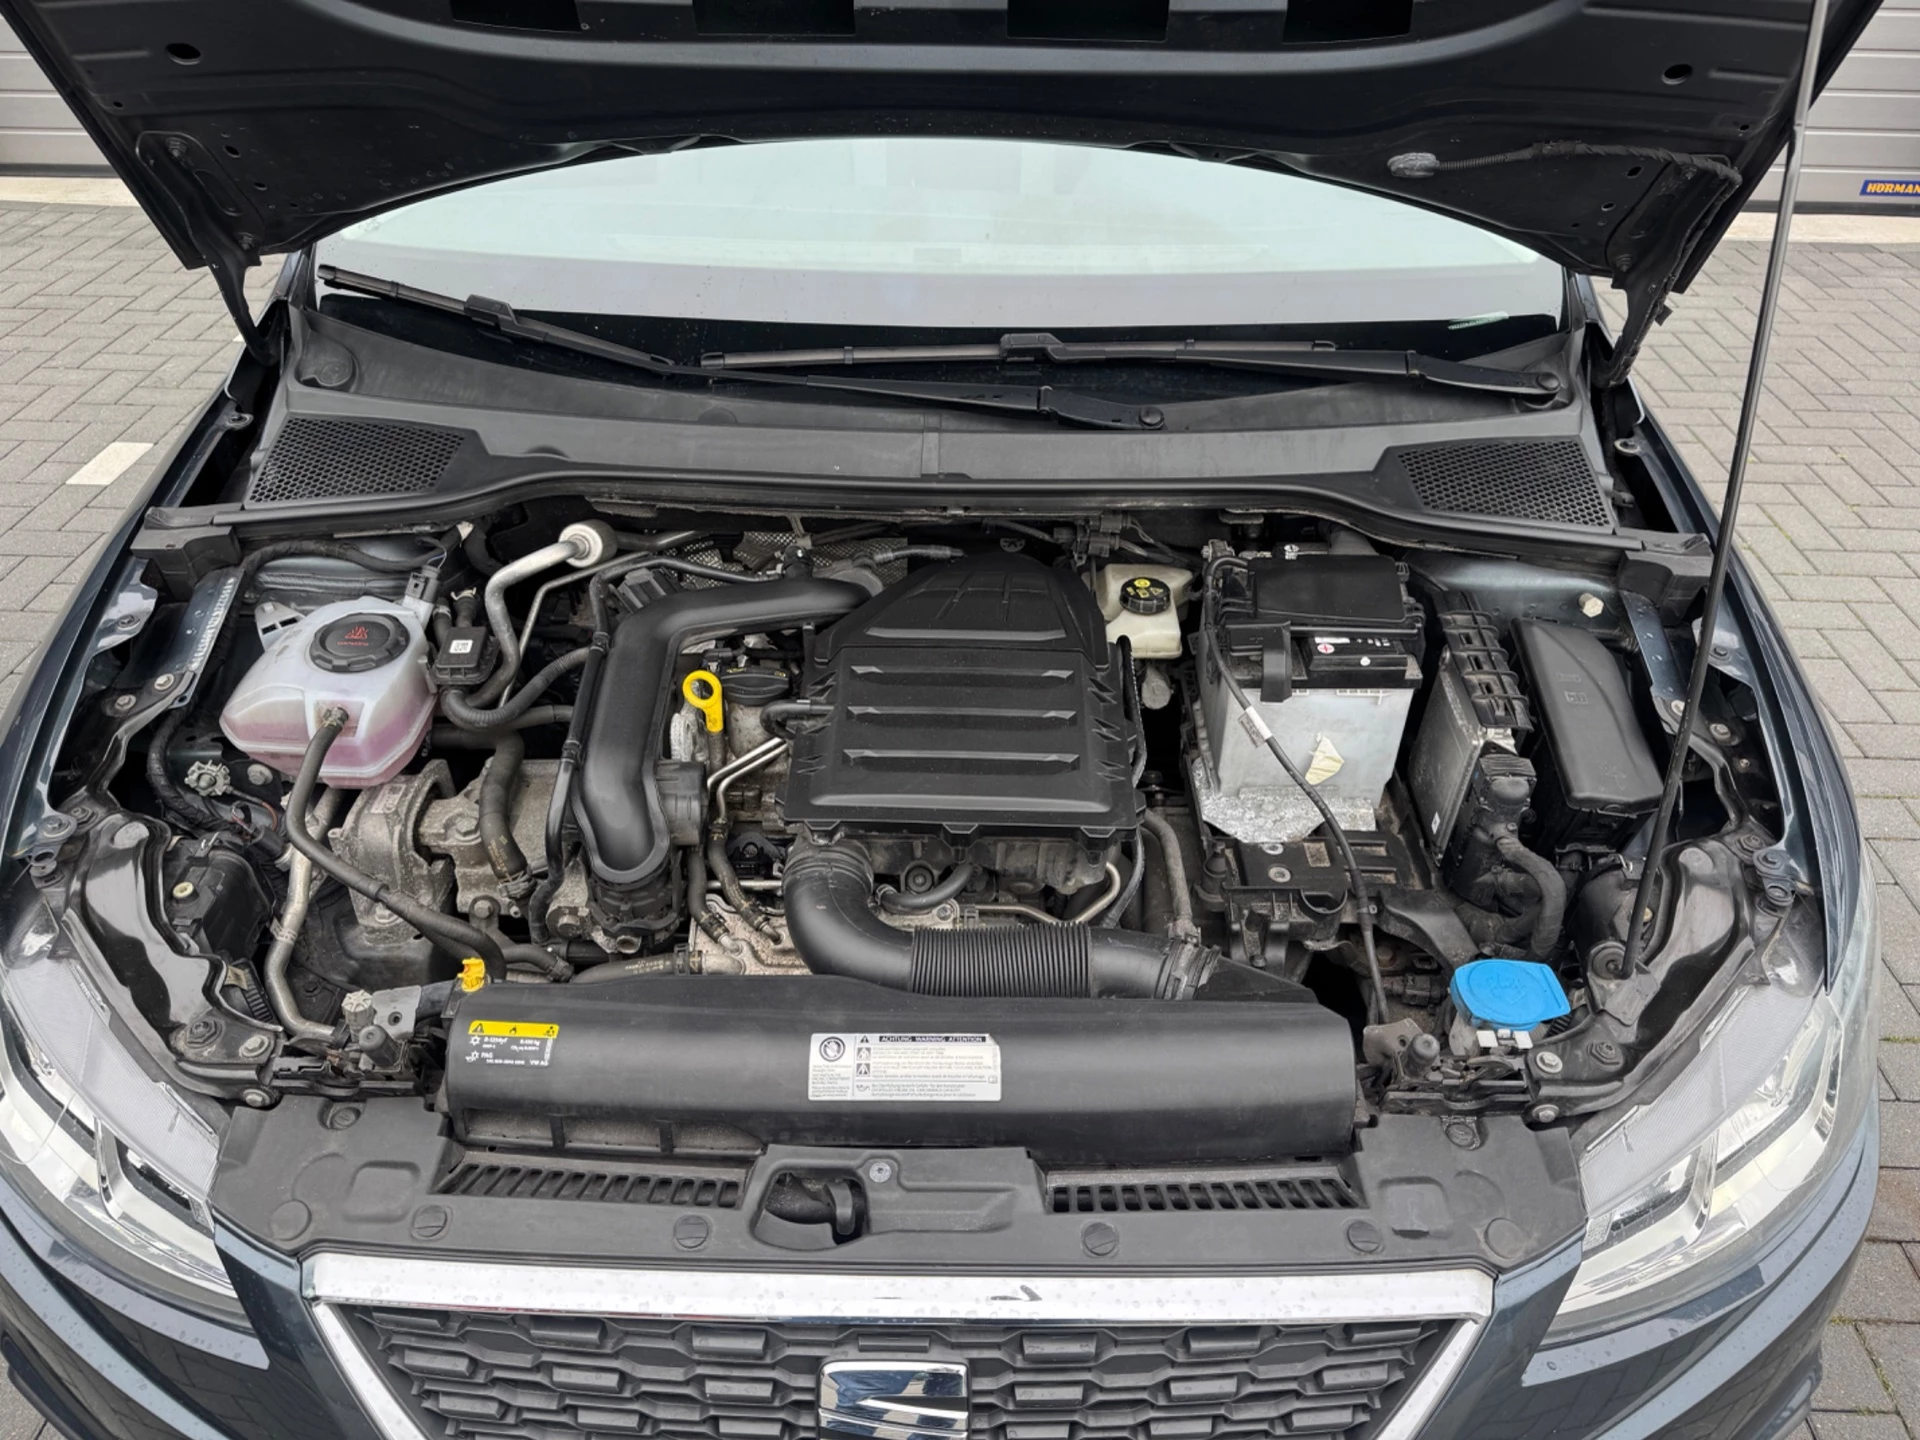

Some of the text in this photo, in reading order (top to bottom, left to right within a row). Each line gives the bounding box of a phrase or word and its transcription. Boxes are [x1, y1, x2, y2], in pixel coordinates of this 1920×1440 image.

[881, 1035, 982, 1043] ACHTUNG WARNING ATTENTION
